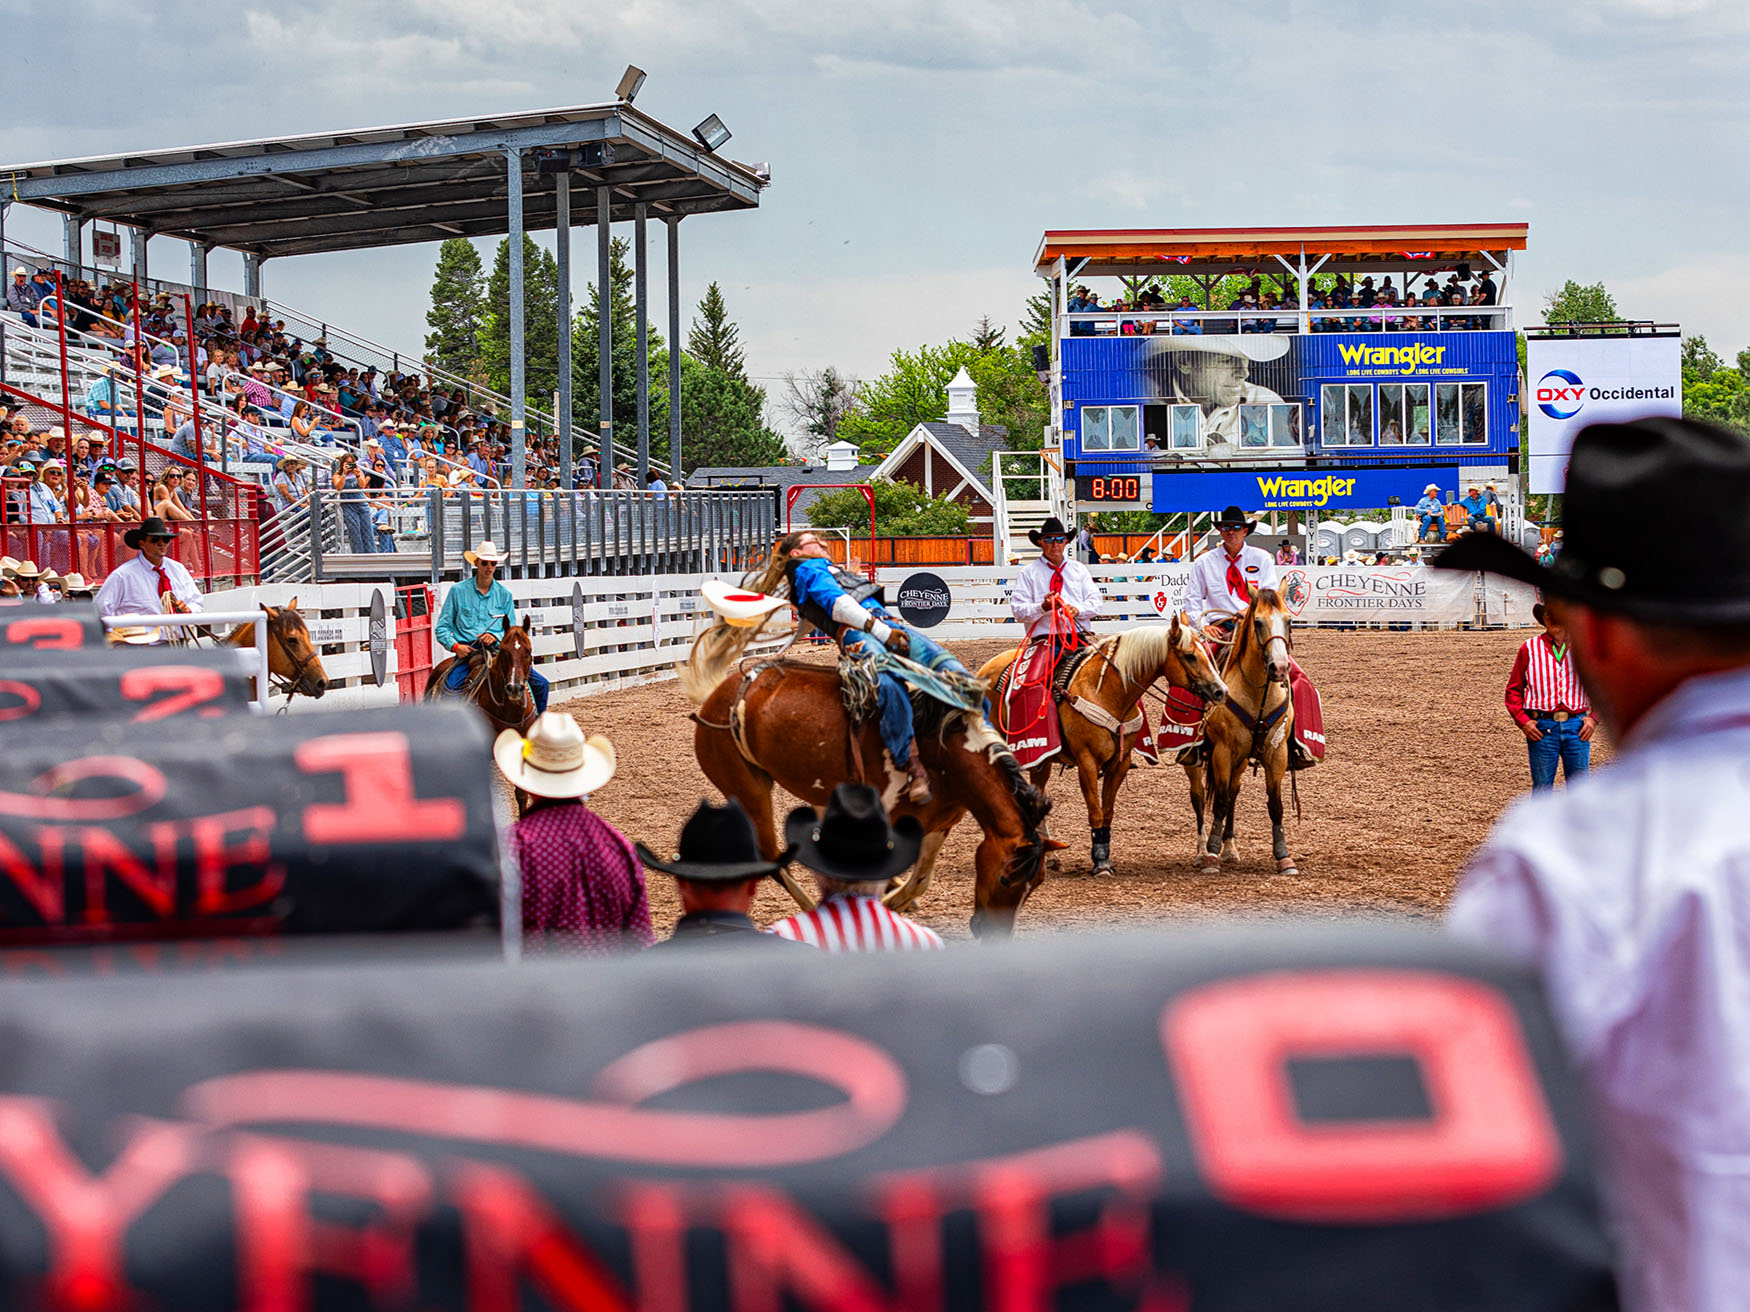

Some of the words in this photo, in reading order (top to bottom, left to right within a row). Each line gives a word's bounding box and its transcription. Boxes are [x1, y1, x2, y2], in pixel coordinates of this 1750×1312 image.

[1338, 343, 1446, 375] Wrangler
[1442, 367, 1469, 375] COWGIRLS
[1537, 388, 1585, 401] OXY
[1590, 386, 1674, 400] Occidental
[1256, 475, 1356, 507] Wrangler
[1315, 574, 1426, 596] CHEYENNE
[900, 590, 949, 600] CHEYENNE
[1318, 598, 1385, 608] FRONTIER
[1389, 598, 1423, 608] DAYS
[1159, 723, 1194, 737] RAM
[295, 731, 466, 844] 1
